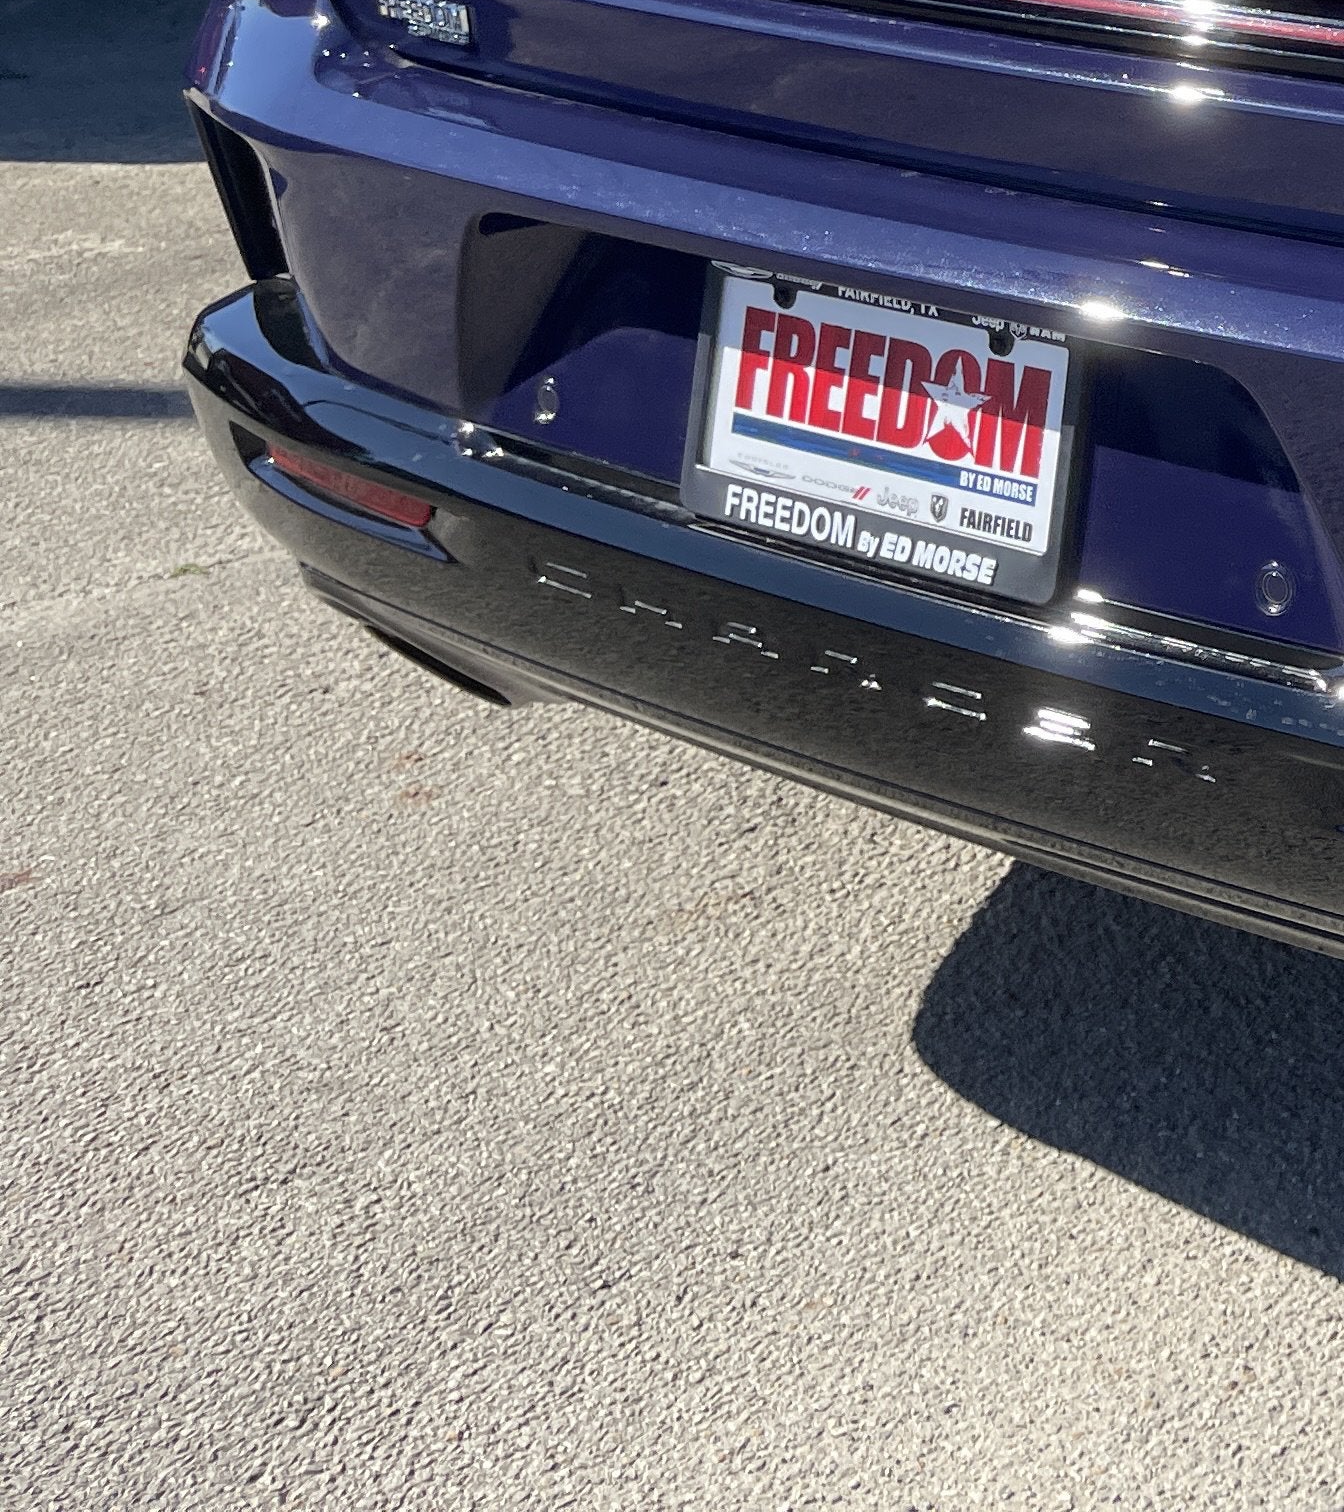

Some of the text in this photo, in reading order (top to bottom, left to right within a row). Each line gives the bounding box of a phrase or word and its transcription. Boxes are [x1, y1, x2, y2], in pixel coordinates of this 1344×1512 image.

[734, 306, 1052, 478] FREEDOM
[876, 487, 920, 516] Jeep
[960, 470, 1034, 503] BY ED MORSE
[725, 484, 857, 549] FREEDOM
[880, 533, 913, 563] ED
[912, 540, 998, 585] MORSE
[960, 507, 1034, 543] FAIRFIELD
